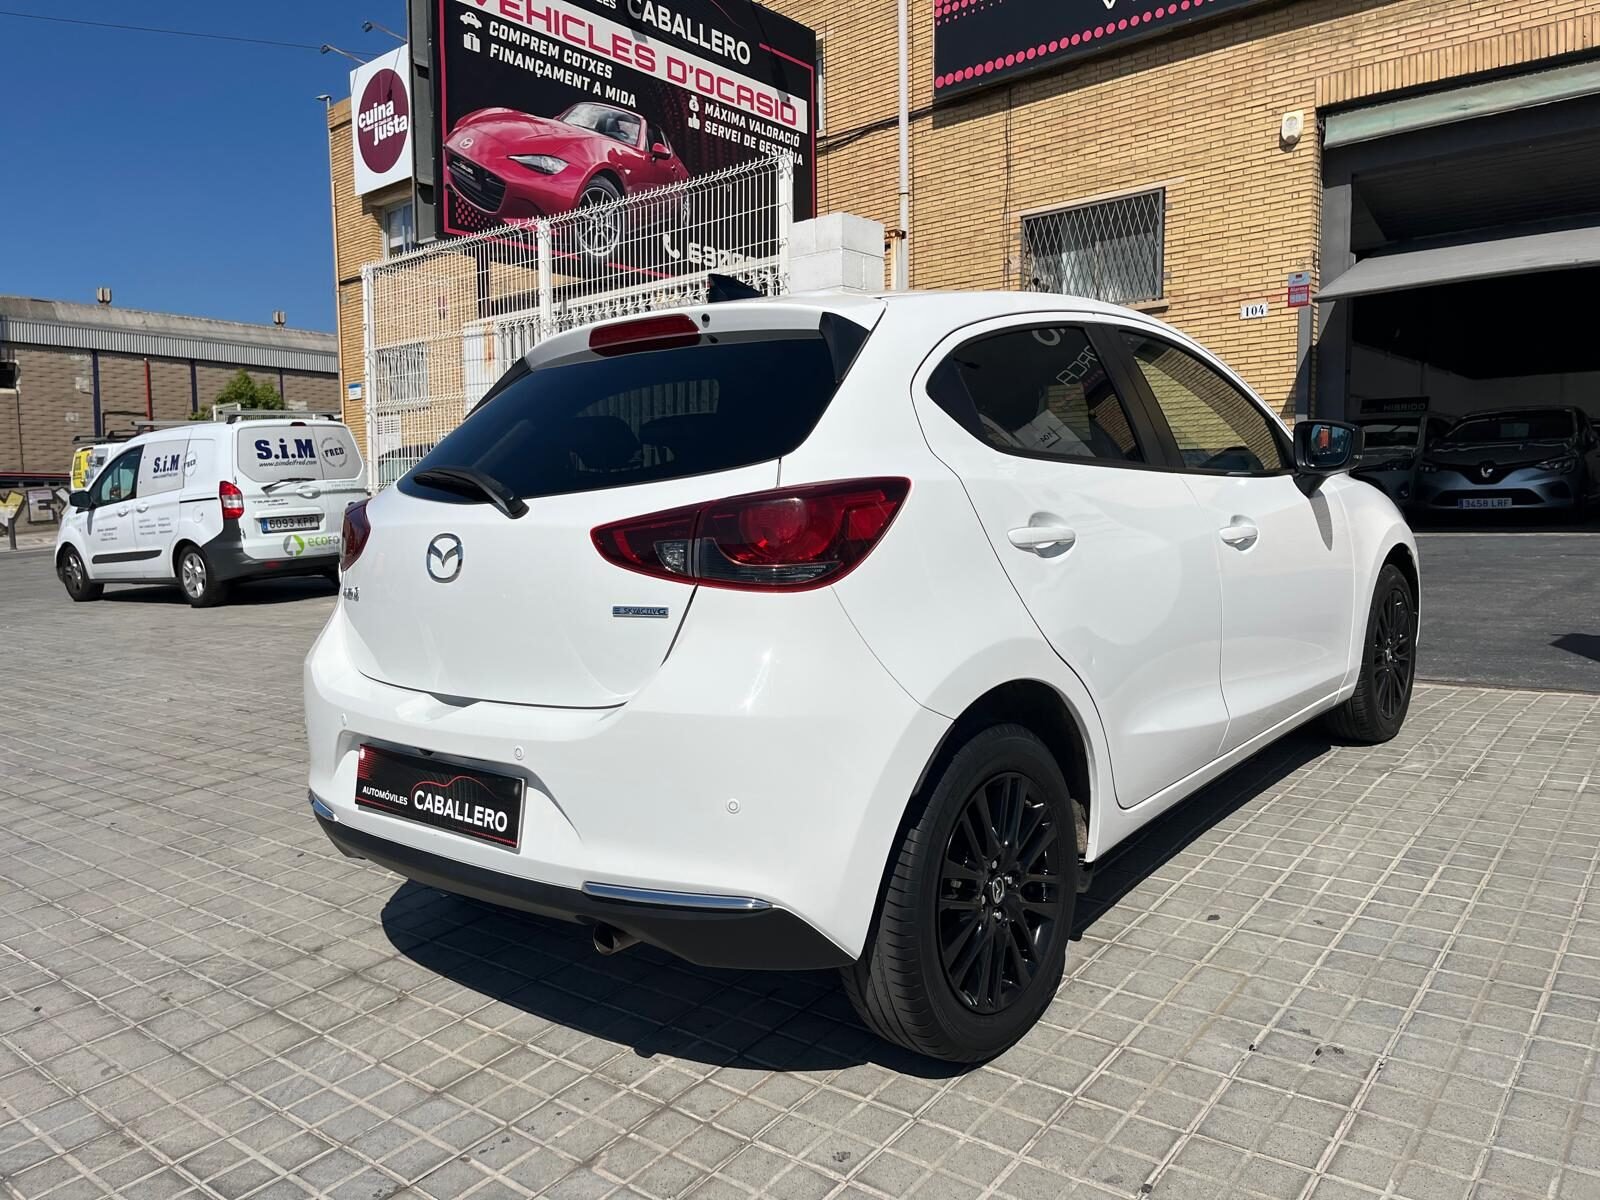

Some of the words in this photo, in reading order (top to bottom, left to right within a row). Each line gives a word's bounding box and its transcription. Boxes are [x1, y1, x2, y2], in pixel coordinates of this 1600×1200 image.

[473, 0, 656, 73] EHICLES
[627, 0, 751, 65] CABALLERO
[489, 21, 560, 60] COMPREM
[563, 48, 613, 79] COTXES
[489, 44, 591, 91] FINANÇAMENT
[592, 81, 602, 96] A
[605, 85, 637, 108] MIDA
[358, 100, 395, 129] cuina
[373, 114, 408, 146] justa
[704, 103, 746, 129] MÀXIMA
[748, 118, 801, 148] VALORACIÓ
[704, 121, 741, 144] SERVEI
[743, 133, 757, 150] DE
[1245, 305, 1264, 317] 104
[255, 438, 316, 460] S.i.M
[324, 447, 345, 458] FRED
[269, 518, 295, 529] 6093
[362, 785, 408, 806] AUTOMÓVILES
[413, 790, 508, 832] CABALLERO
